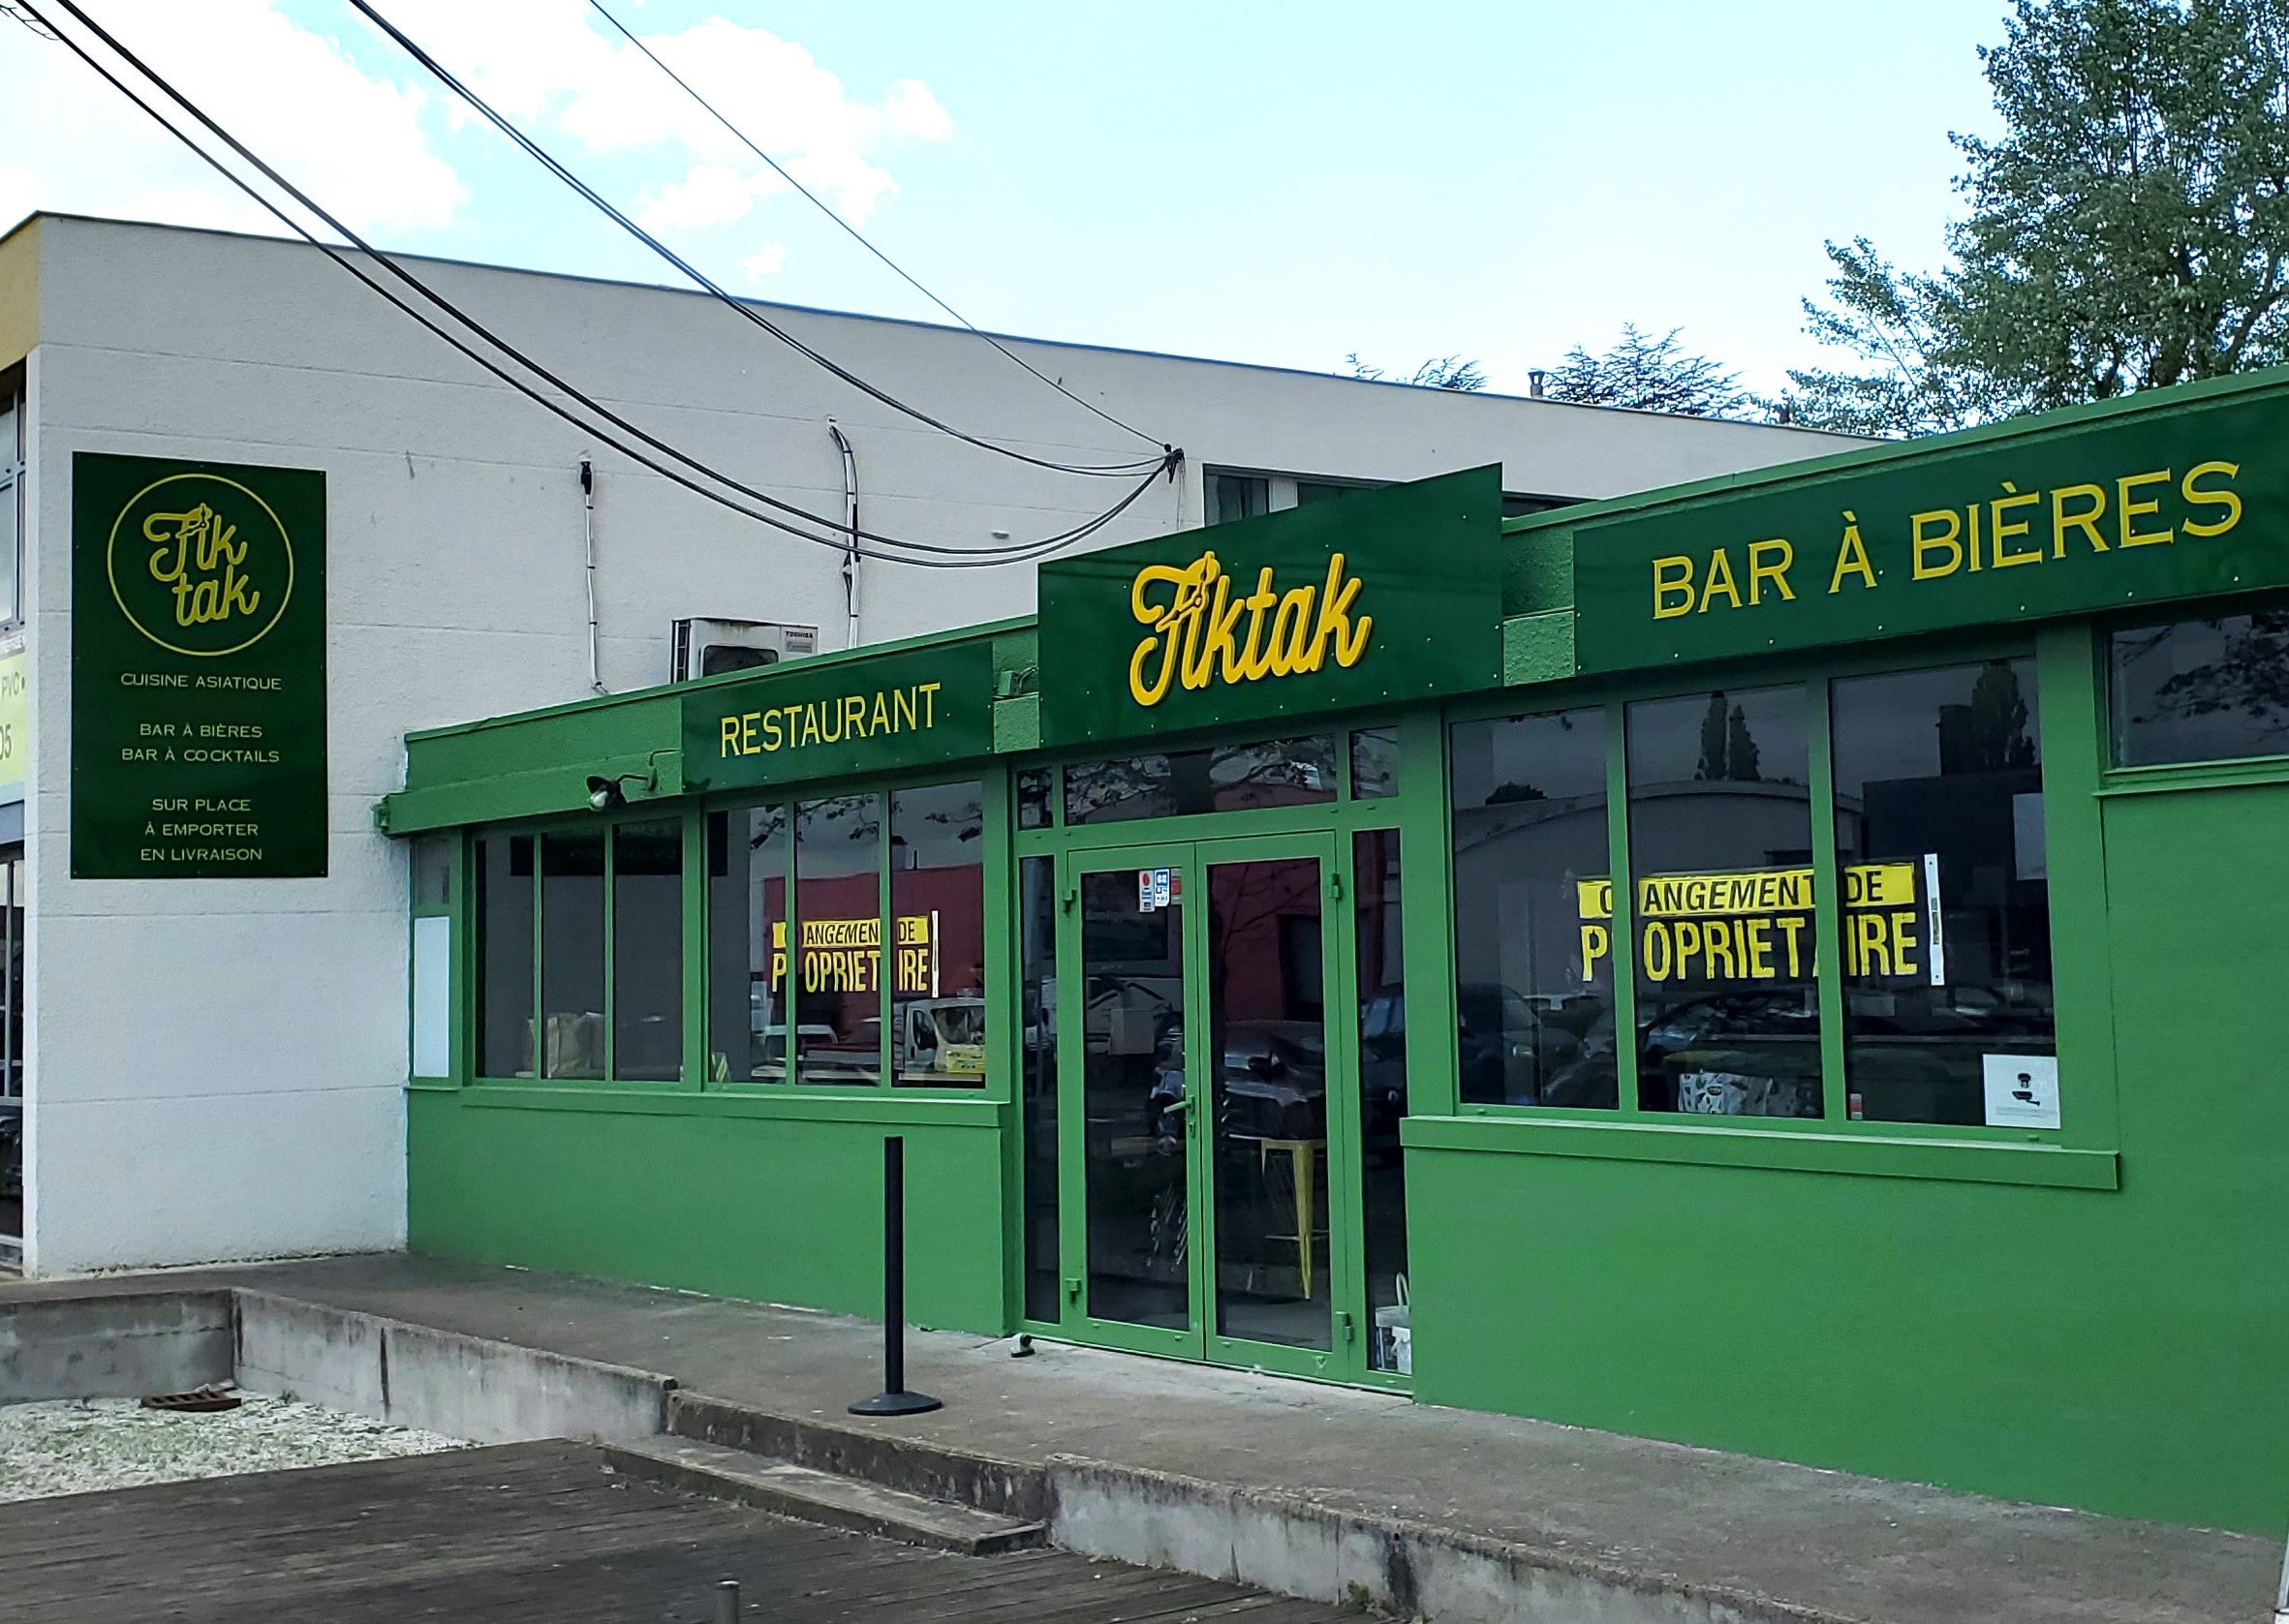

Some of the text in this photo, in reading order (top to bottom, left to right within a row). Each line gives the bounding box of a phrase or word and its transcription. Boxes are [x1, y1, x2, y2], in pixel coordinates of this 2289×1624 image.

[1652, 460, 2243, 620] BAR À BIÈRES
[171, 565, 261, 627] tak
[1129, 550, 1373, 707] Tiktak
[121, 673, 283, 690] CUISINE ASIATIQUE
[139, 722, 263, 738] BAR À BIÈRES
[720, 680, 941, 758] RESTAURANT
[122, 747, 280, 763] BAR À COCKTAILS
[152, 798, 253, 812] SUR PLACE
[144, 821, 260, 837] À EMPORTER
[140, 848, 263, 861] EN LIVRAISON
[1847, 870, 1885, 903] DE
[898, 920, 915, 942] DE
[1580, 911, 1919, 982] POPRIETIRE
[771, 948, 929, 994] POPRIETIRE
